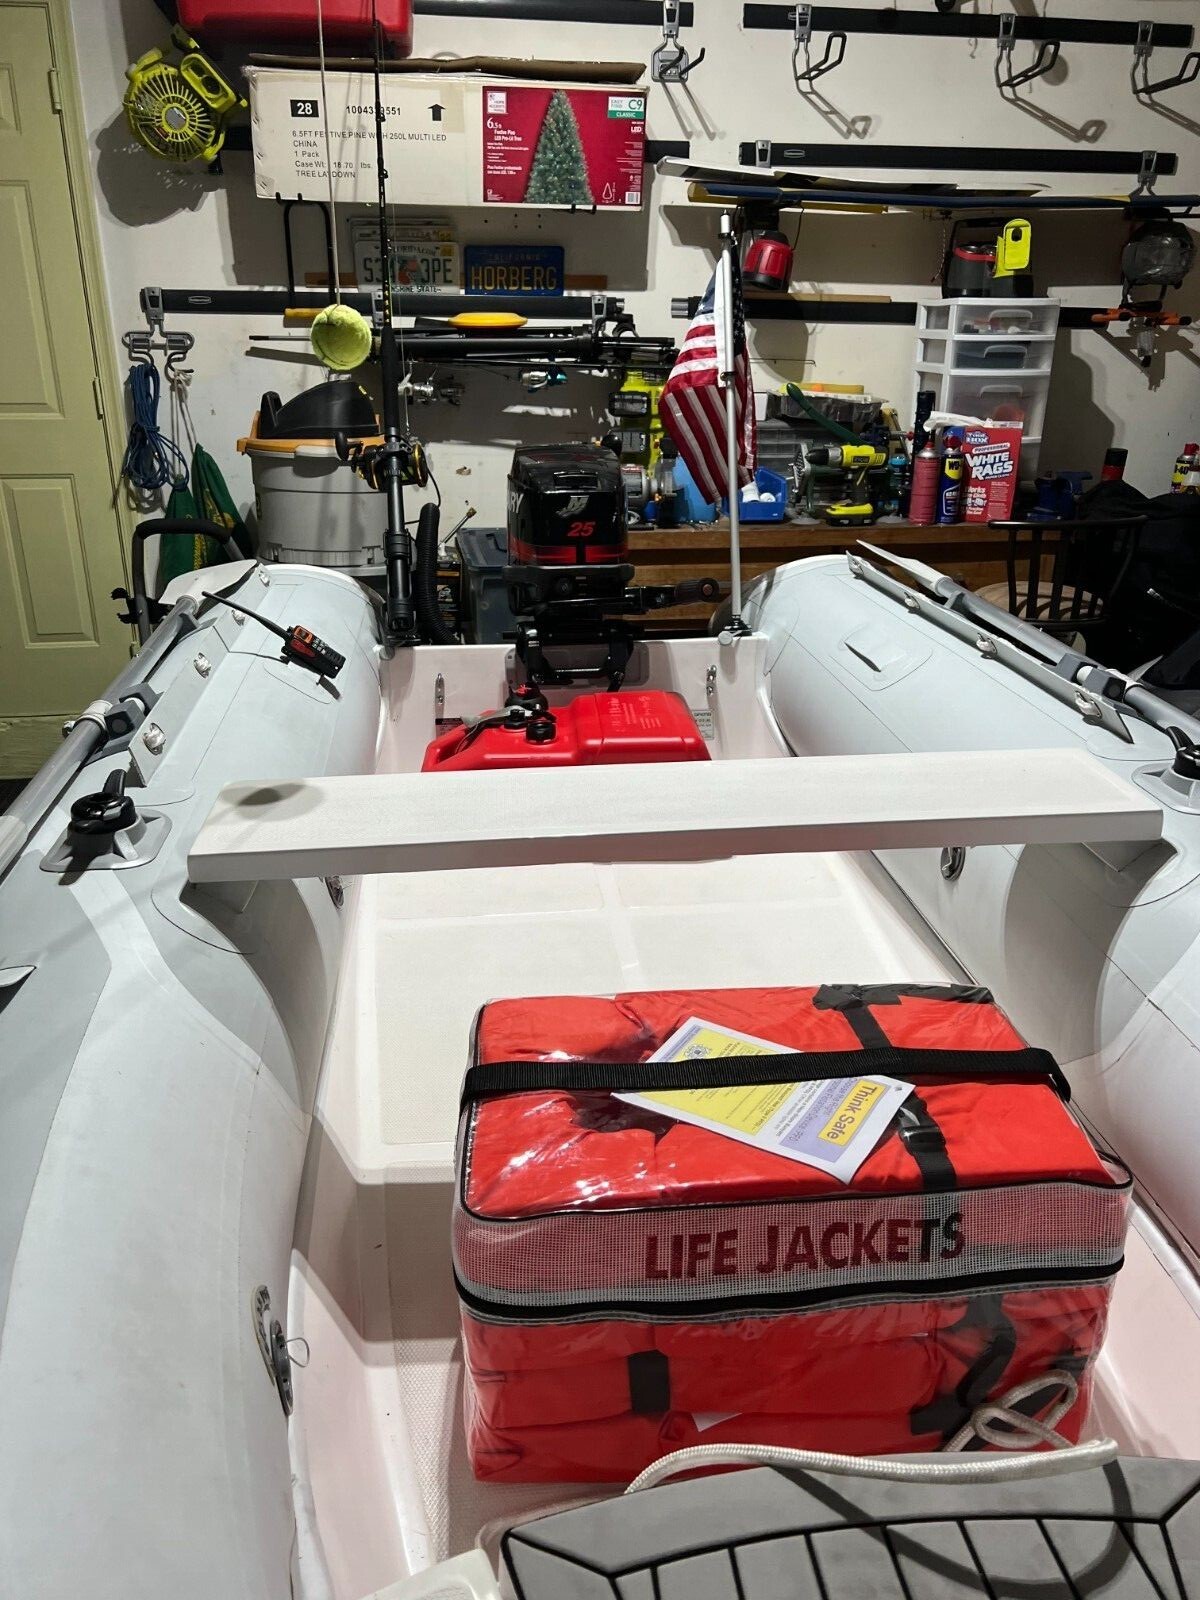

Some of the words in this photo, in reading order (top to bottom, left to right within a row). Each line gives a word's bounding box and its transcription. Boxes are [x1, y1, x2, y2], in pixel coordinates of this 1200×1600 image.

[297, 102, 313, 115] 28
[629, 99, 642, 110] C9
[292, 130, 312, 138] 6.5FT
[314, 131, 347, 139] FETIVE
[348, 131, 367, 139] PINE
[408, 133, 431, 141] MULTI
[293, 140, 318, 148] CHINA
[295, 160, 313, 168] Case
[295, 170, 316, 178] TREE
[471, 266, 558, 291] HORBERG
[965, 452, 1010, 467] WHITE
[971, 460, 1014, 480] RAGS
[567, 521, 596, 537] 25
[844, 1085, 878, 1114] Think
[826, 1114, 855, 1140] Safe
[645, 1229, 739, 1280] LIFE
[756, 1212, 966, 1274] JACKETS
